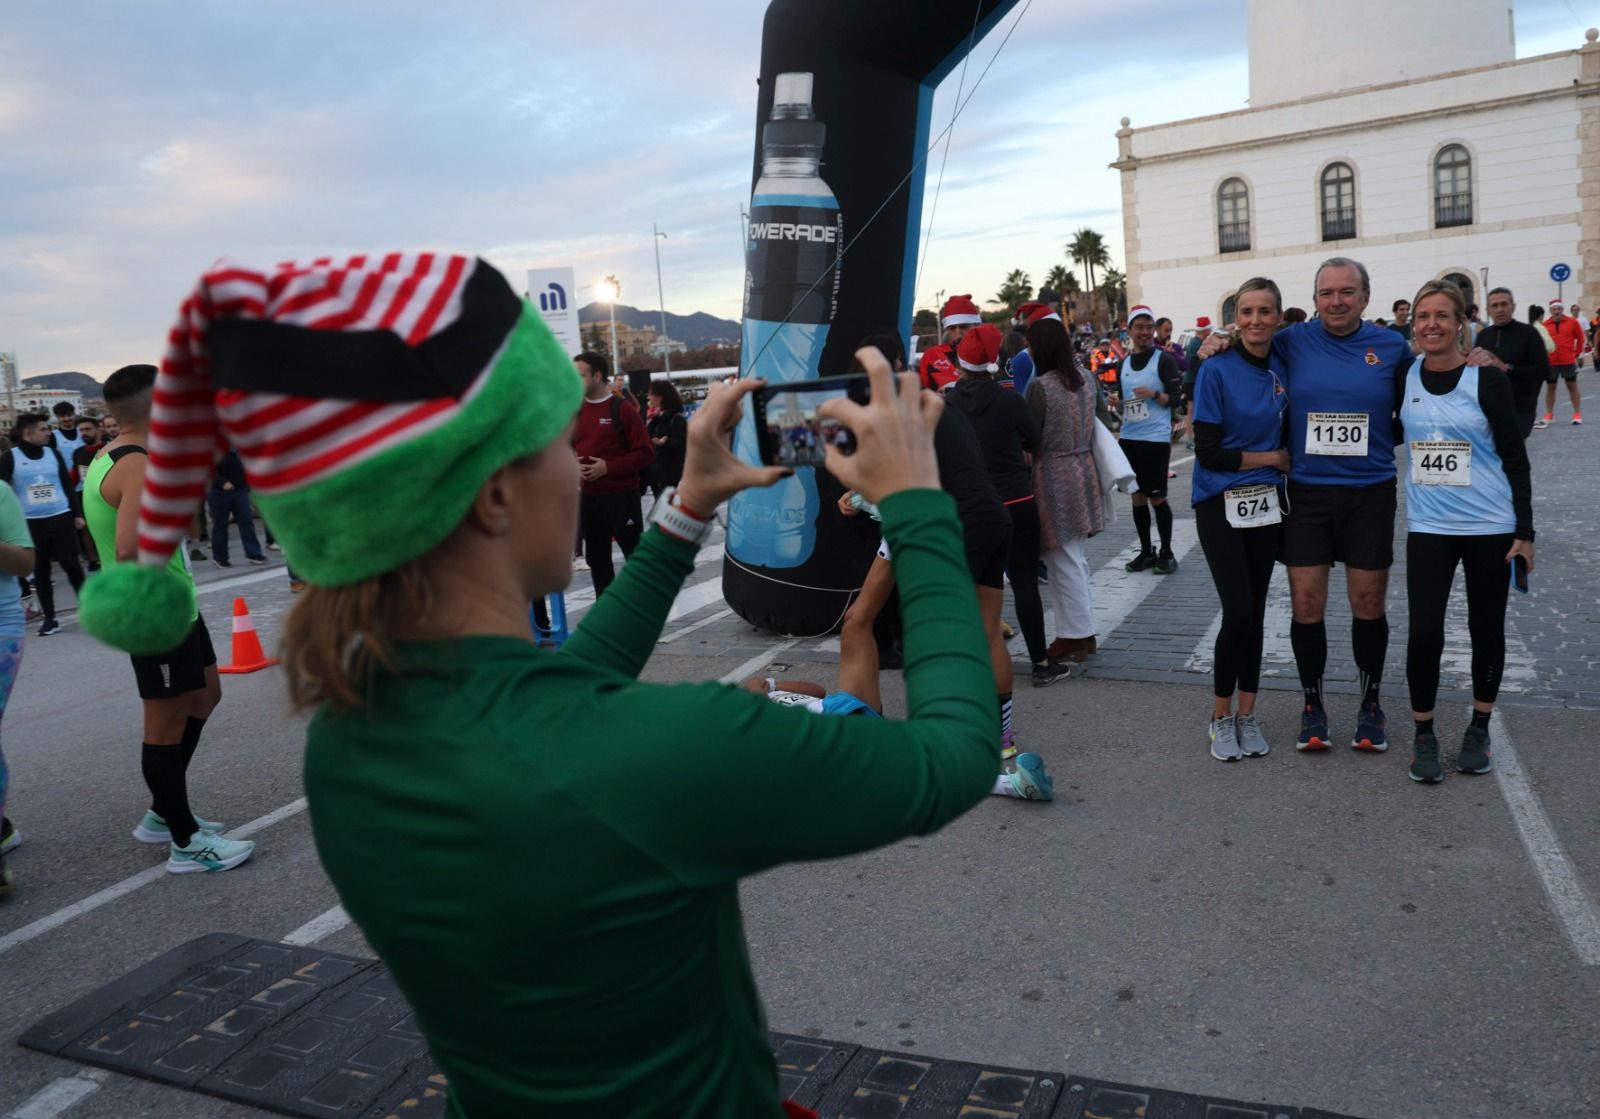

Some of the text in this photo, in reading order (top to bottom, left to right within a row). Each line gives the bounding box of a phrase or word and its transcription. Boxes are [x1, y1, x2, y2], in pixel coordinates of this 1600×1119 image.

[749, 223, 837, 243] OWERADE
[1313, 425, 1361, 443] 1130
[1421, 453, 1458, 472] 446
[1237, 496, 1270, 517] 674
